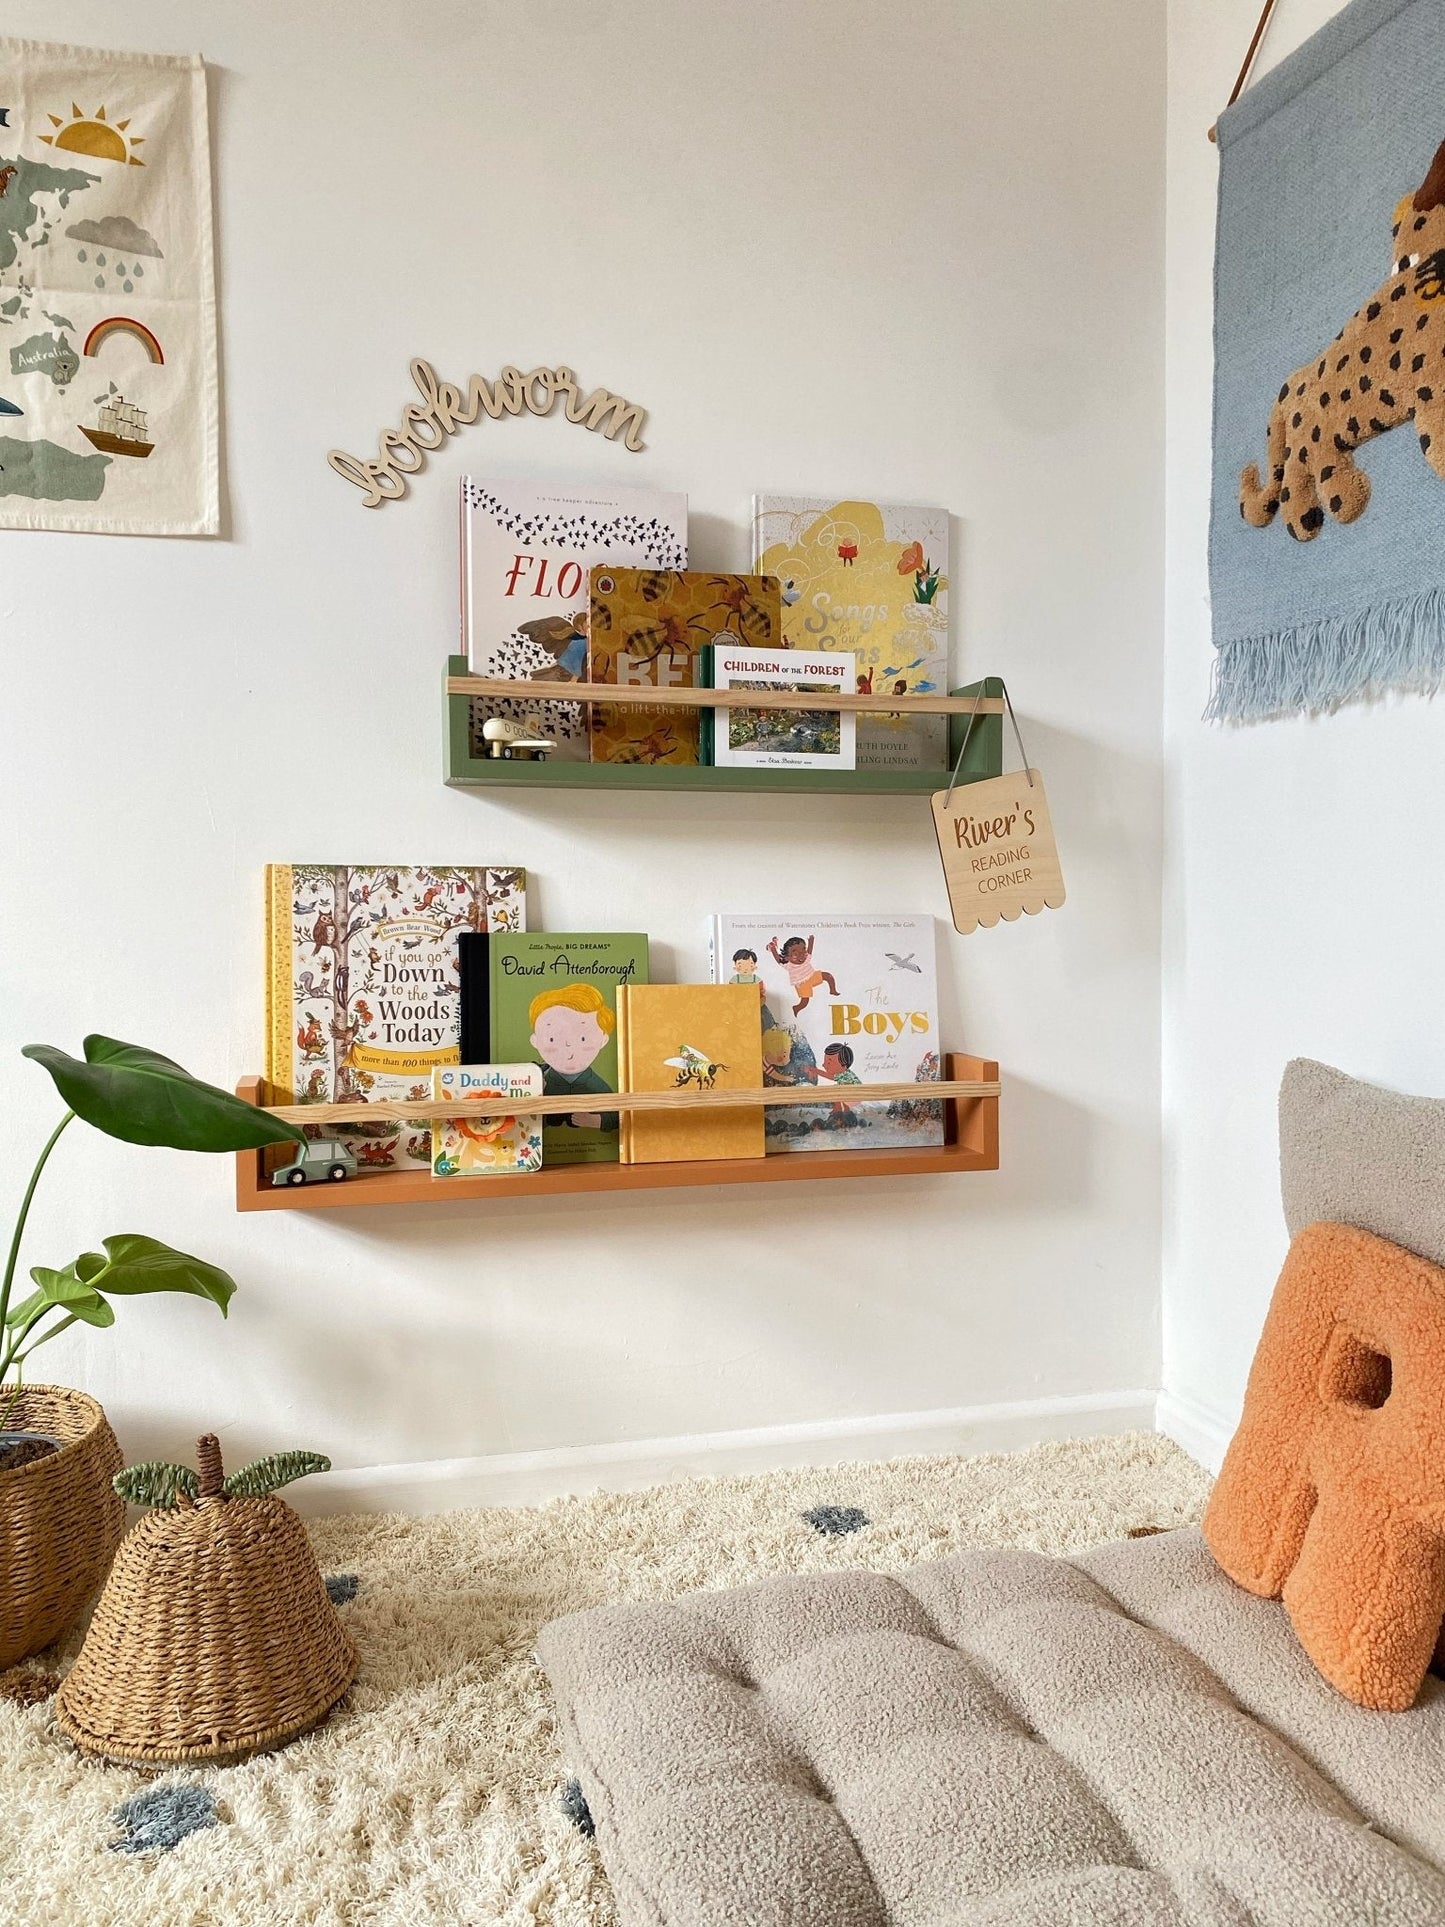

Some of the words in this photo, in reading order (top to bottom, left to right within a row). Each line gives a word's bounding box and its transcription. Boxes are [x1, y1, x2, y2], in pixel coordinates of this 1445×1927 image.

[18, 347, 71, 367] Australia
[326, 357, 646, 508] bookworm
[504, 554, 638, 599] FLO
[804, 592, 888, 633] Songs
[841, 634, 862, 644] our
[616, 652, 700, 688] BE
[723, 661, 780, 673] CHILDREN
[804, 665, 846, 677] FOREST
[620, 706, 628, 714] a
[880, 743, 908, 751] DOYLE
[883, 757, 919, 765] LINDSAY
[953, 801, 1036, 849] River's
[971, 845, 1031, 873] READING
[977, 867, 1033, 894] CORNER
[383, 925, 405, 935] Brown
[423, 924, 442, 934] Wood
[385, 944, 396, 961] if
[399, 953, 422, 968] you
[427, 953, 442, 968] go
[383, 963, 445, 983] Down
[501, 955, 545, 975] David
[549, 954, 636, 985] Attenborough
[391, 984, 404, 996] to
[407, 985, 428, 1001] the
[865, 986, 889, 1005] The
[378, 1000, 450, 1021] Woods
[828, 1004, 930, 1043] Boys
[382, 1023, 446, 1046] Today
[361, 1055, 381, 1064] more
[382, 1057, 400, 1066] than
[402, 1059, 418, 1068] 100
[419, 1058, 442, 1066] things
[460, 1073, 508, 1091] Daddy
[510, 1075, 531, 1086] and
[510, 1088, 531, 1098] Me
